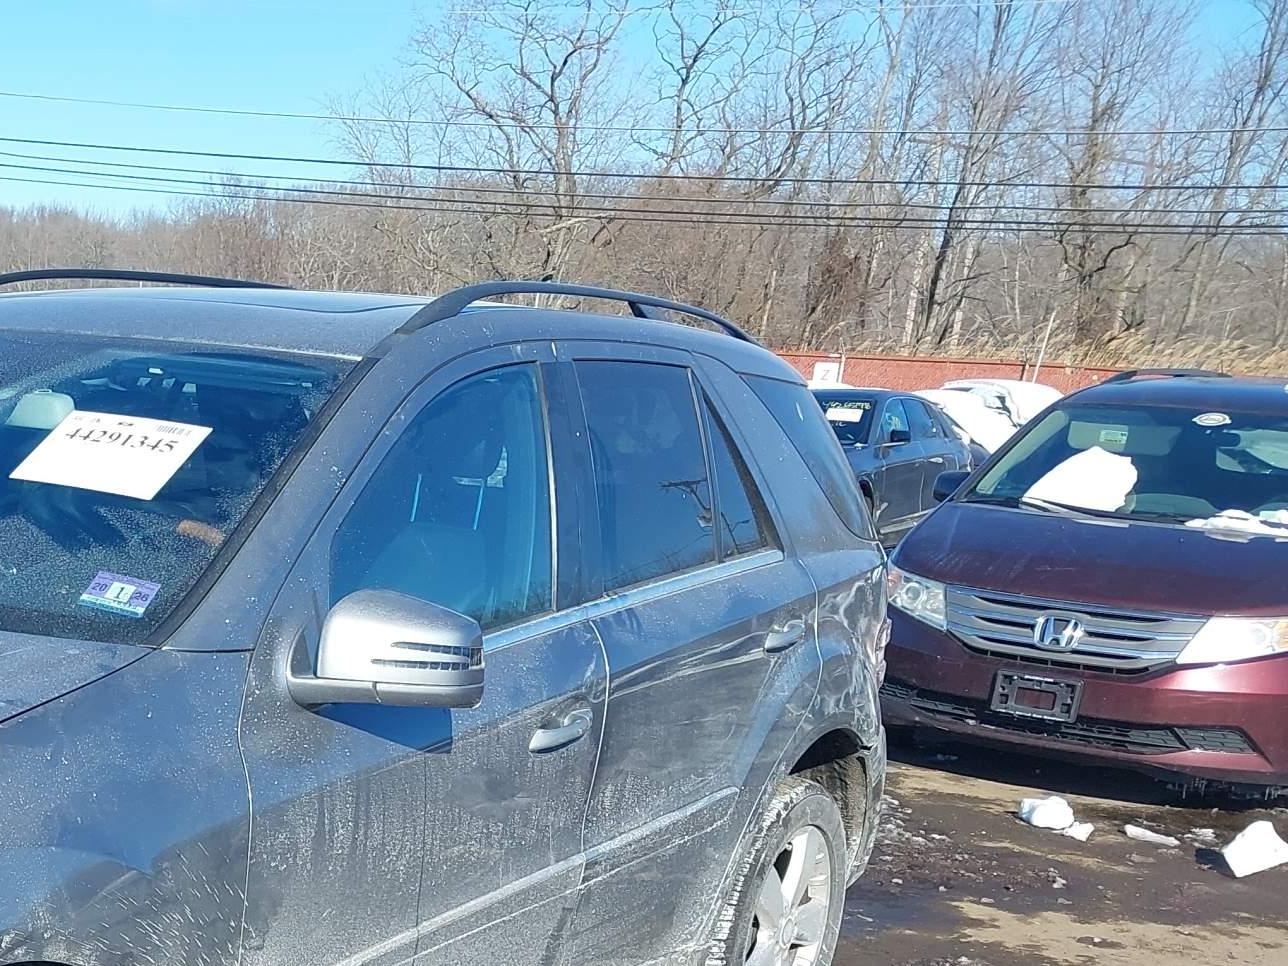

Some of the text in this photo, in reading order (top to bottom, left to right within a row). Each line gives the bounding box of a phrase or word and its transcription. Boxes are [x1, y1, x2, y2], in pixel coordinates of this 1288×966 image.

[65, 427, 179, 453] 44291345
[91, 582, 109, 592] 20
[133, 591, 150, 602] 26
